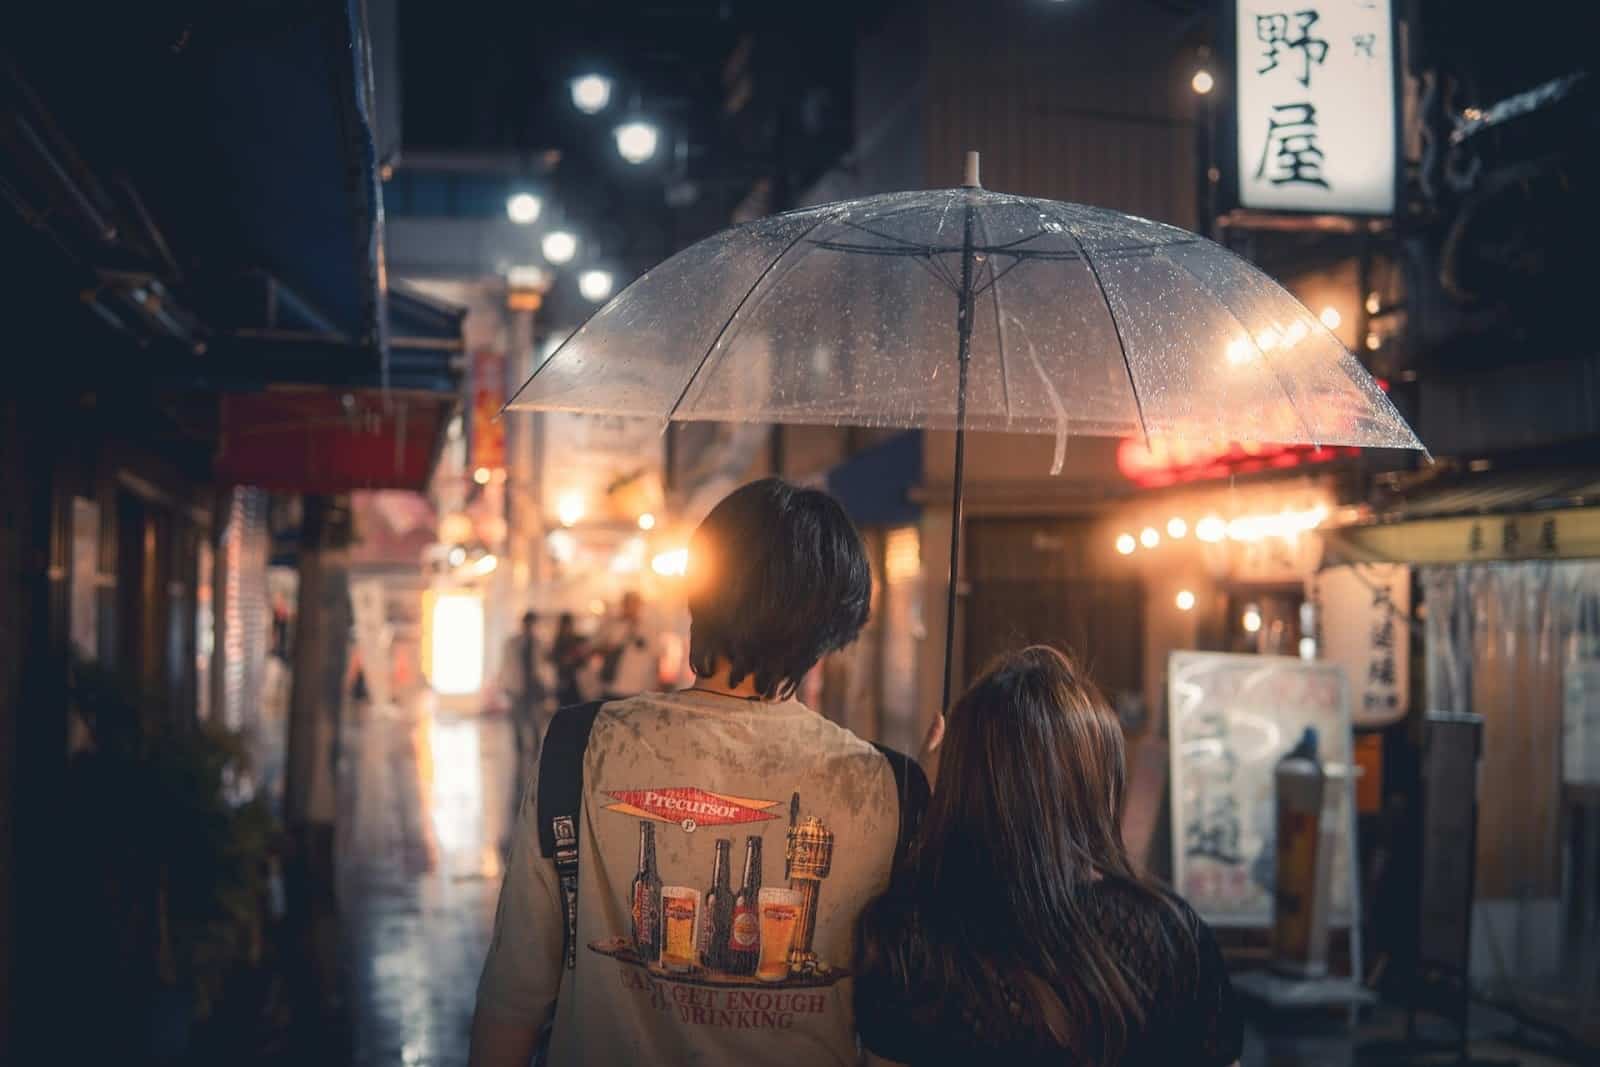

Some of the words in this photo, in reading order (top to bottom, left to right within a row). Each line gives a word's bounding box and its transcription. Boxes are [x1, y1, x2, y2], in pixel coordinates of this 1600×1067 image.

[644, 791, 740, 818] Precursor
[672, 985, 716, 1008] GET
[727, 991, 825, 1013] ENOUGH
